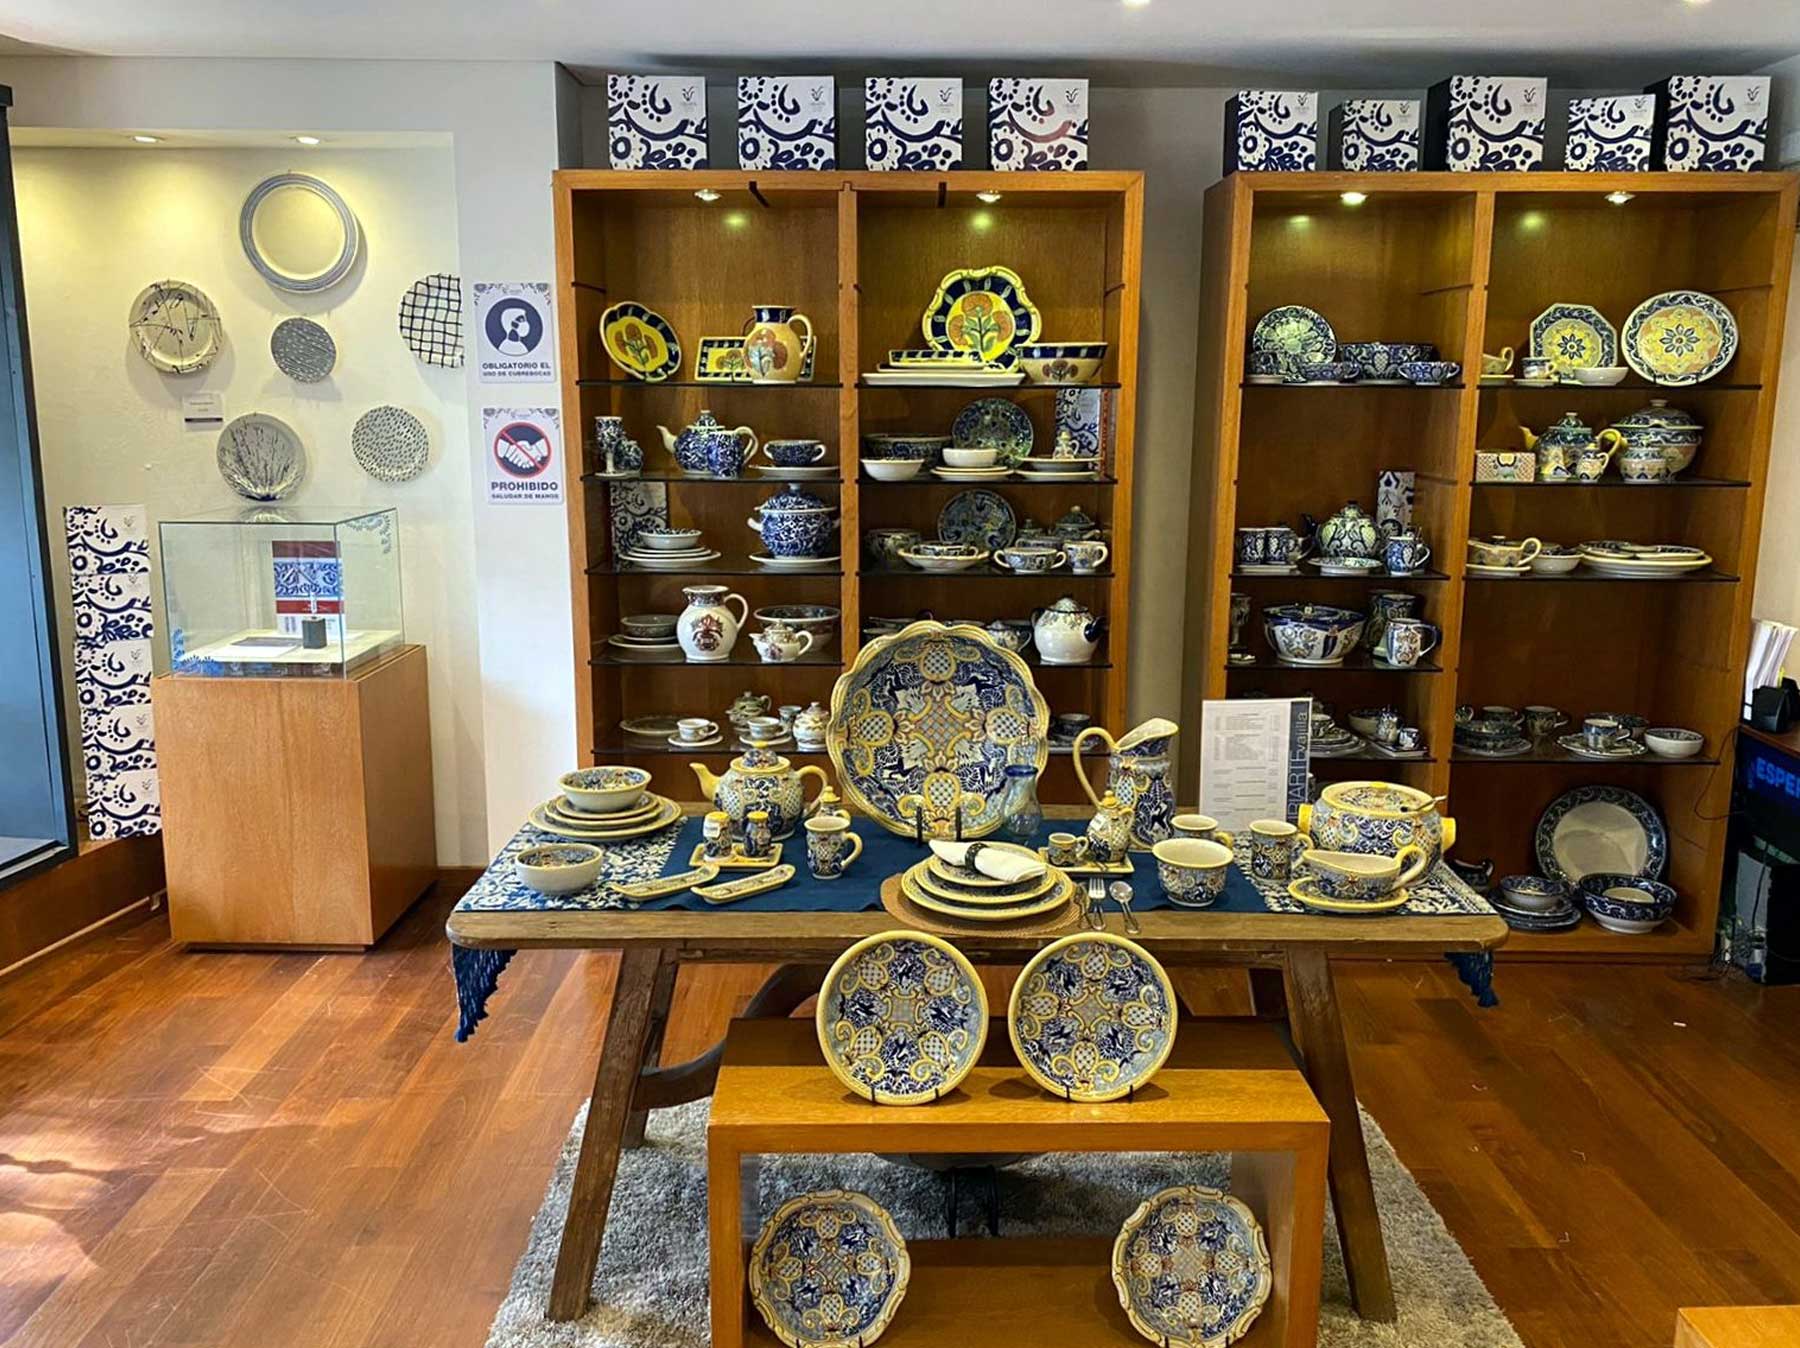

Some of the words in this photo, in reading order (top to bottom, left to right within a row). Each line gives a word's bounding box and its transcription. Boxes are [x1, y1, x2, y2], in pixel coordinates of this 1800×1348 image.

[482, 362, 538, 370] OBLIGATORIO
[540, 361, 551, 369] EL
[491, 482, 558, 491] PROHIBIDO
